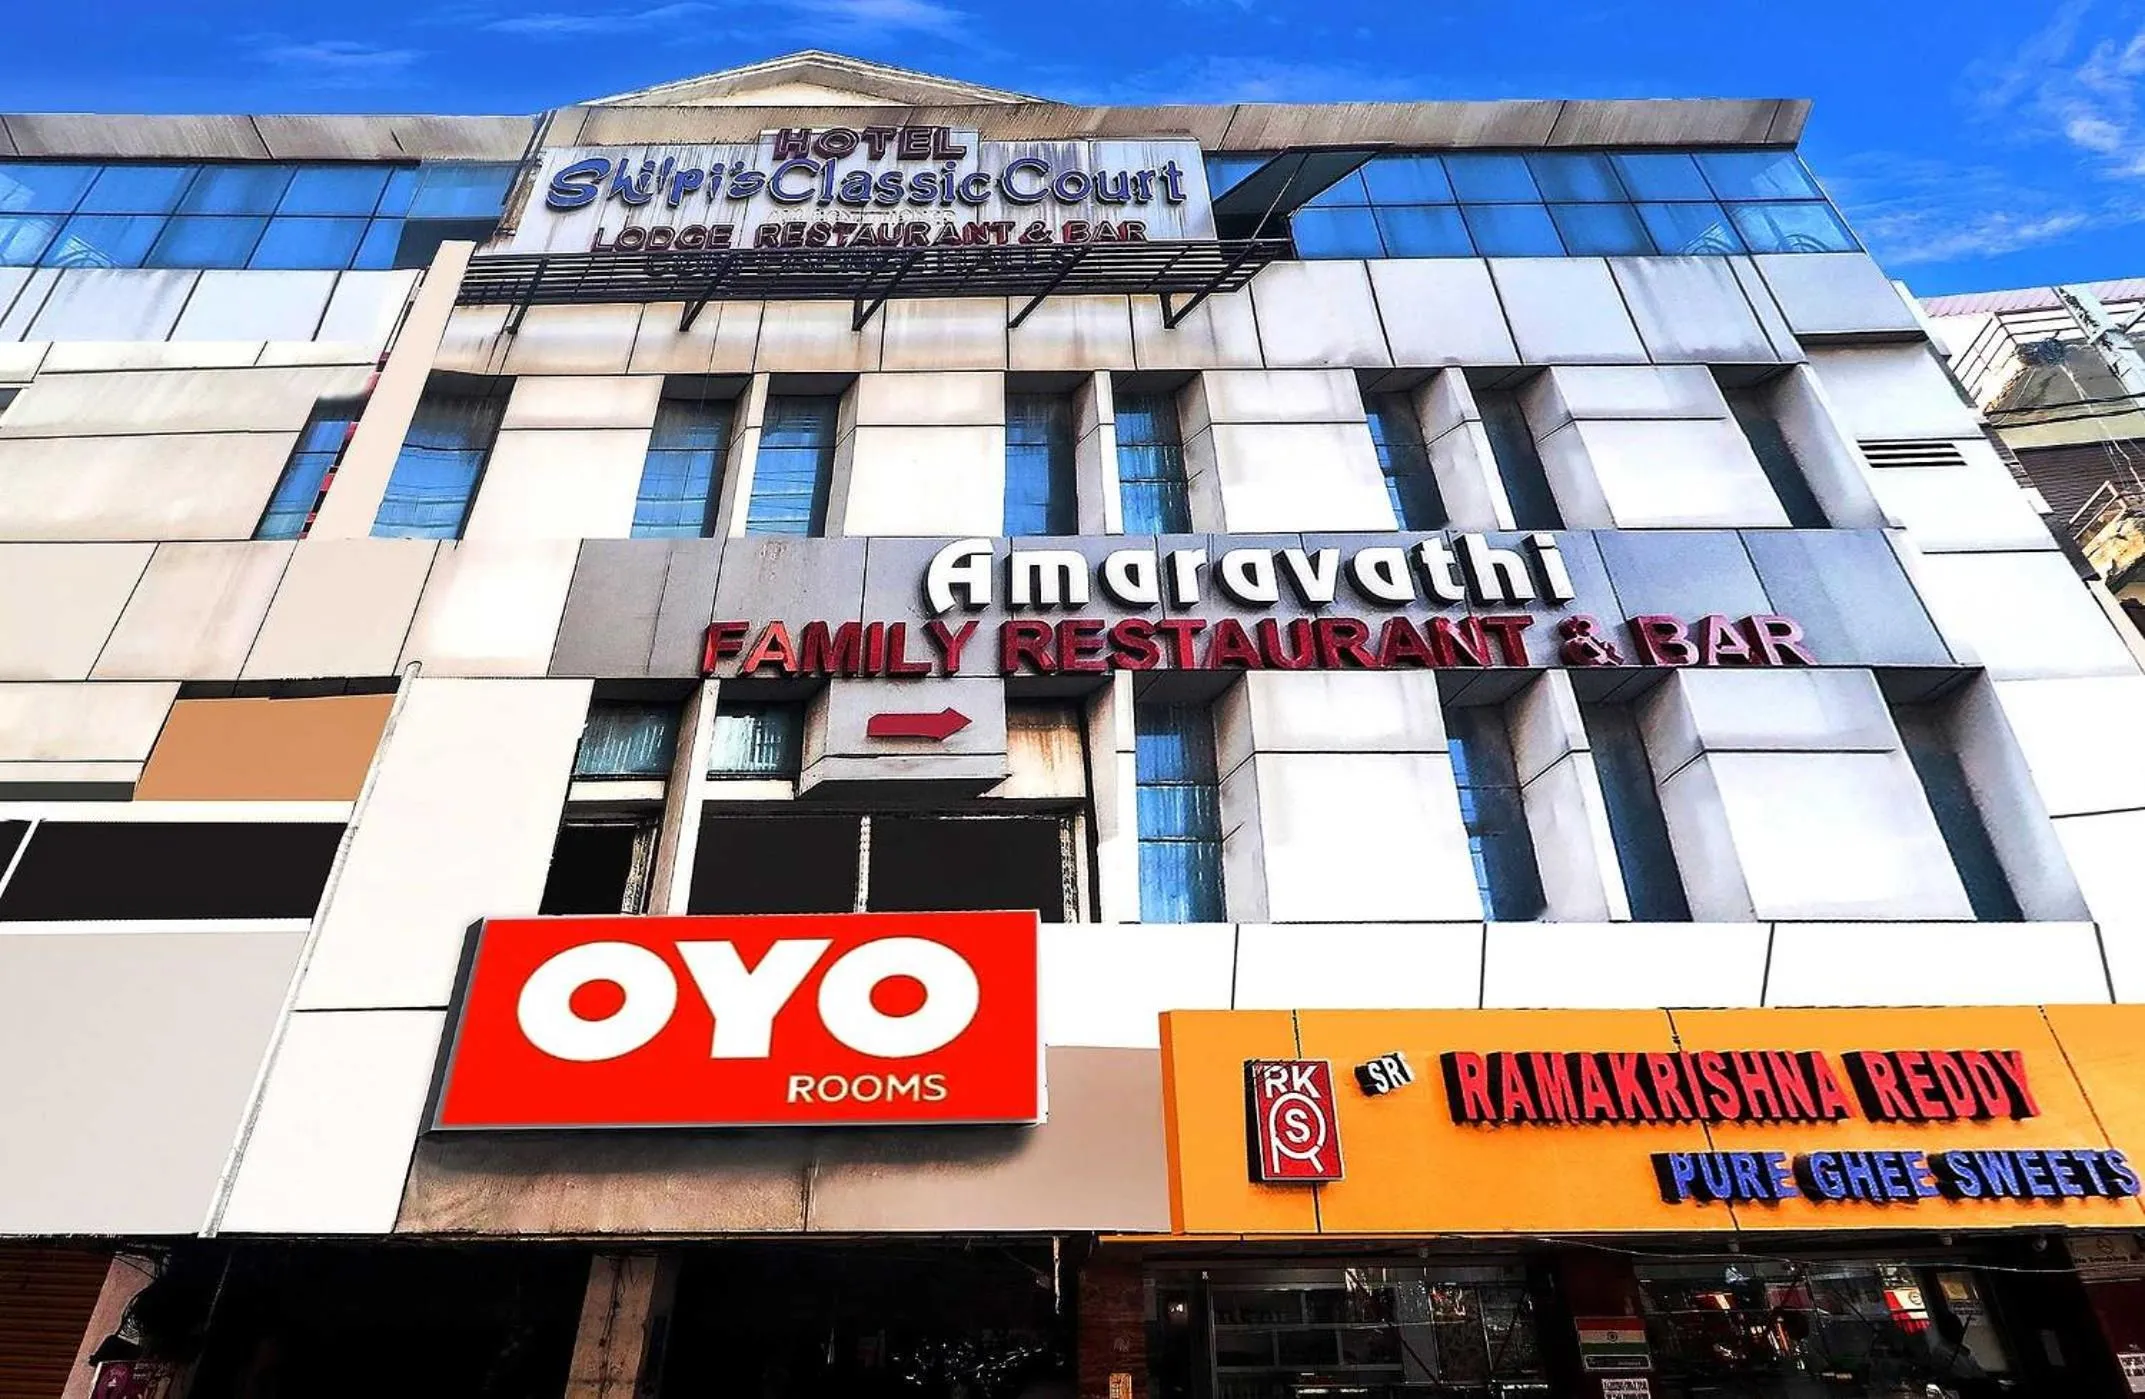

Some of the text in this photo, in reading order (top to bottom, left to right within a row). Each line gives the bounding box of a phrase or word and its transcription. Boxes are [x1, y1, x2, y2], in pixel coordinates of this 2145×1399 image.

[773, 126, 968, 161] HOTEL
[768, 156, 993, 206] Classic
[1001, 156, 1188, 205] Court
[593, 218, 1149, 252] LODGE RESTAURANT & BAR
[925, 532, 1575, 613] Amaravathi
[702, 612, 1819, 674] FAMILY RESTAURANT & BAR
[516, 935, 981, 1062] OYO
[786, 1072, 949, 1104] ROOMS
[1264, 1064, 1322, 1099] RK
[1364, 1049, 2041, 1121] SRI RAMAKRISHNA REDDY
[1662, 1149, 2143, 1200] PURE GHEE SWEETS
